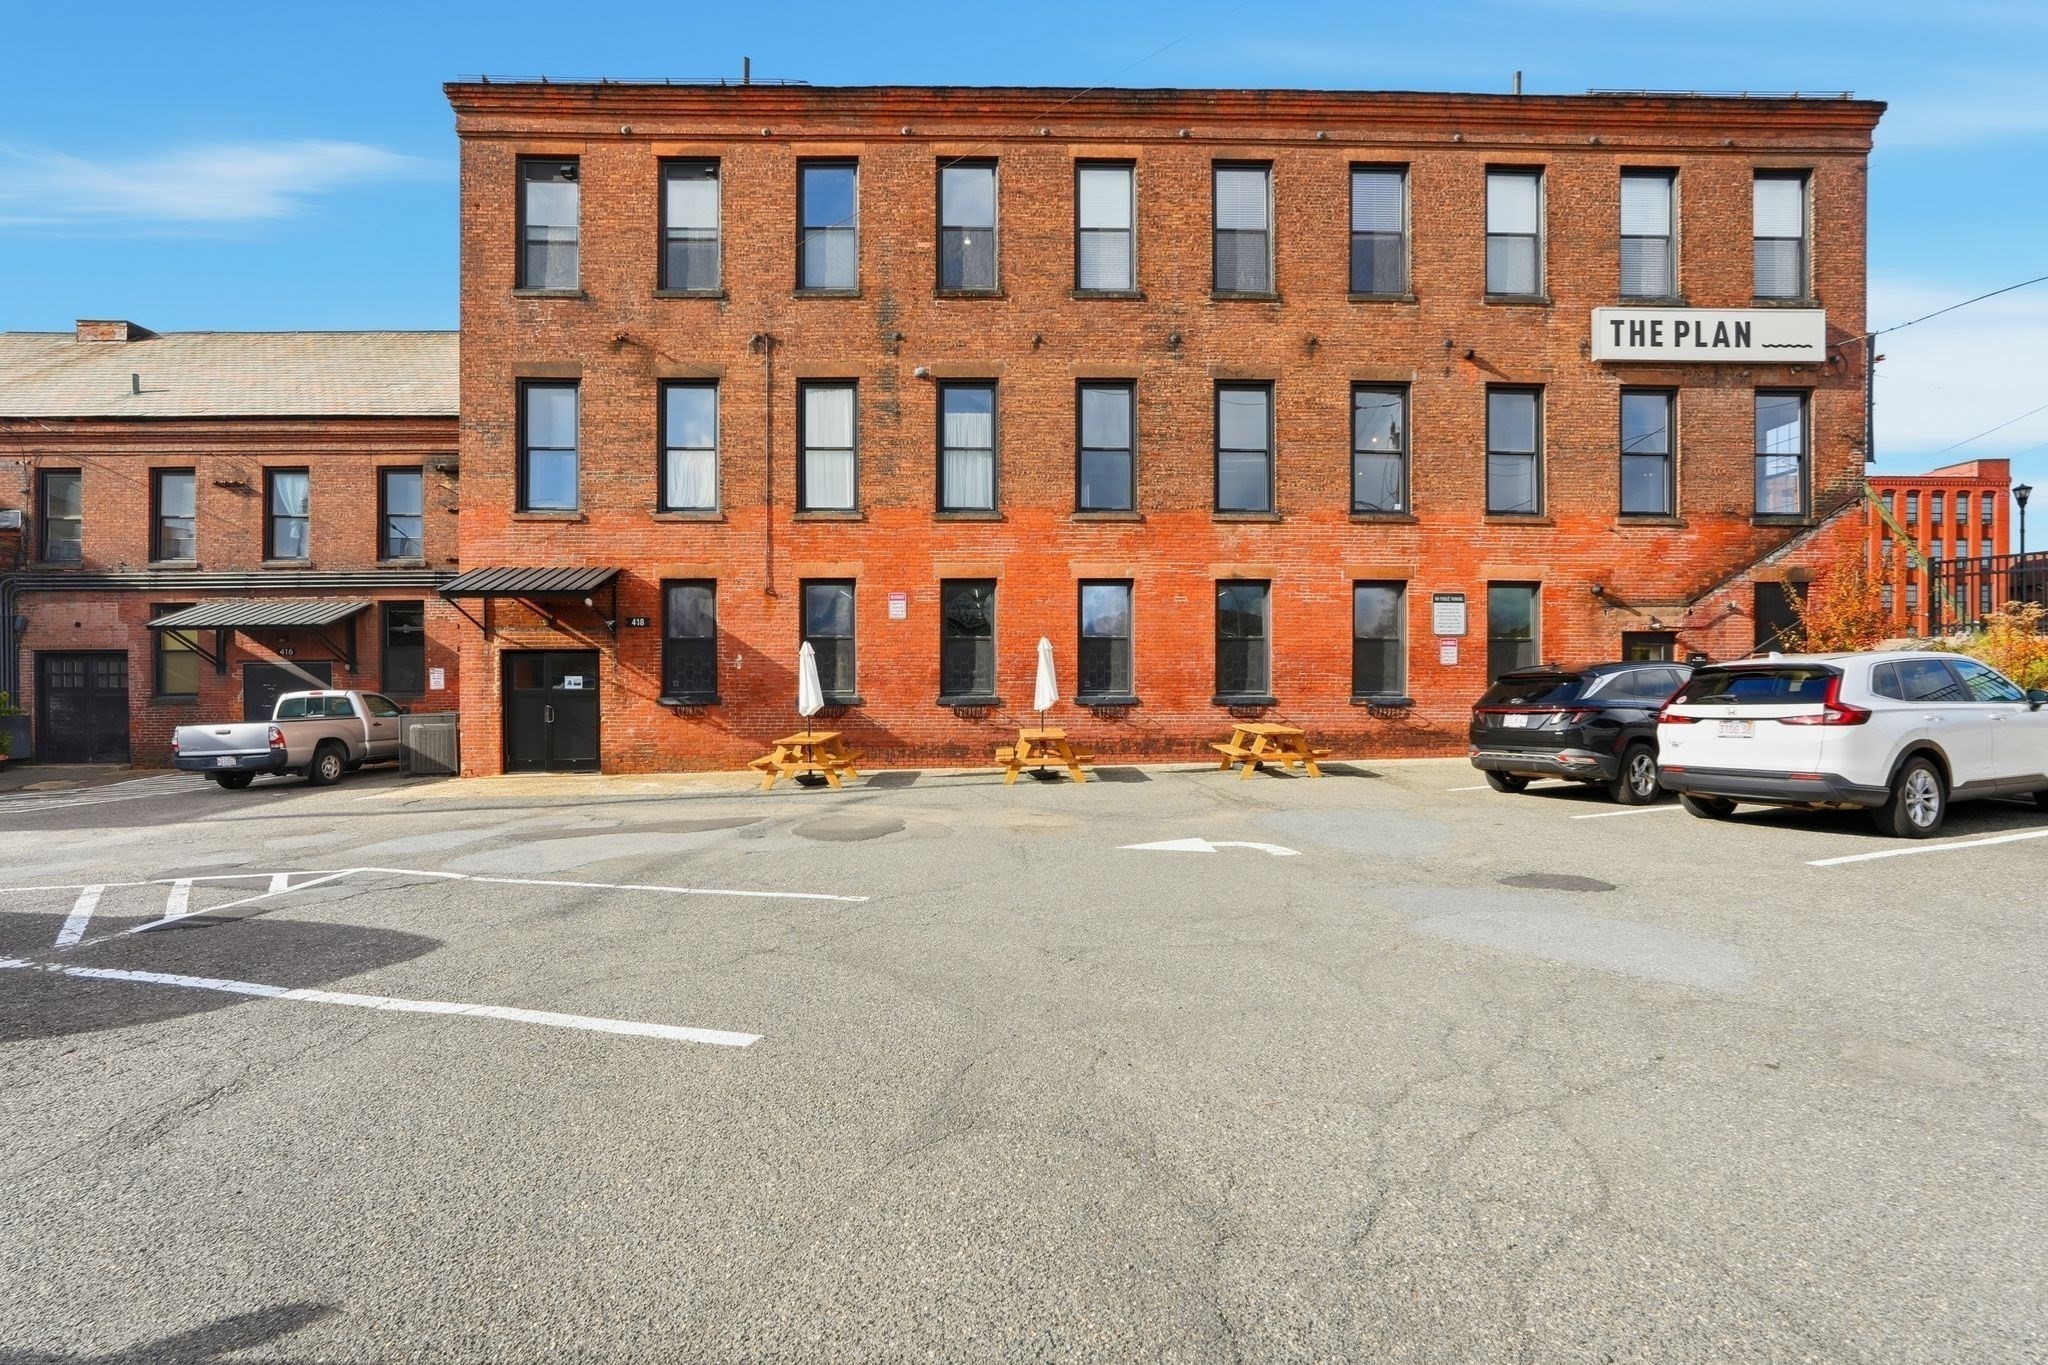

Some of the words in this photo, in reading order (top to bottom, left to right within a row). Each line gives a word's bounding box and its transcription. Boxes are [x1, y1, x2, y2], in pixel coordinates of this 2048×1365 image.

[1610, 319, 1663, 347] THE
[1674, 320, 1751, 348] PLAN
[631, 618, 645, 626] 418
